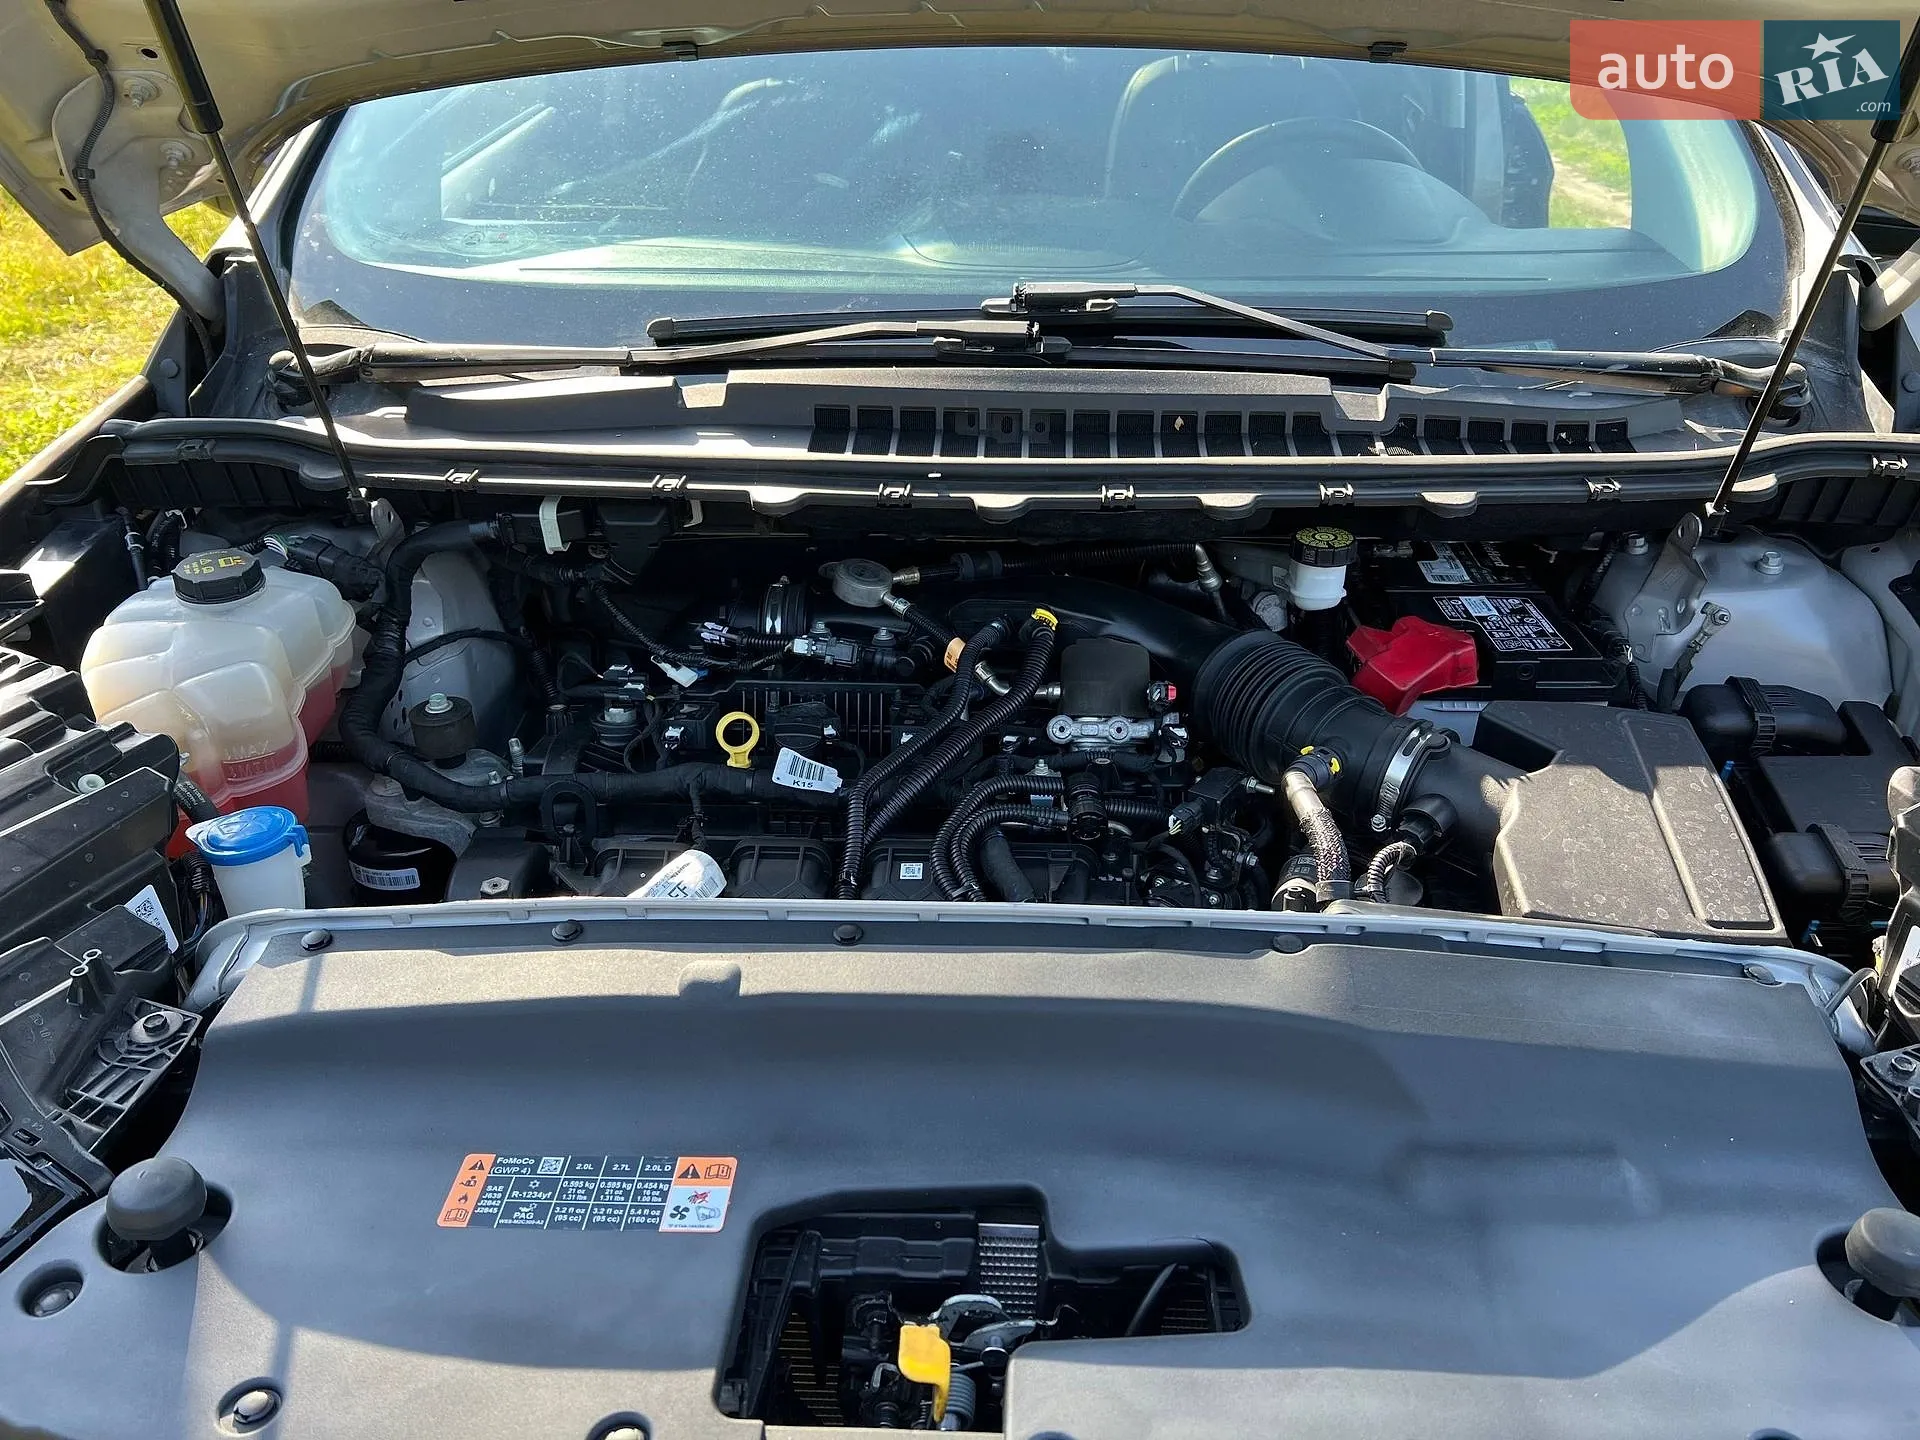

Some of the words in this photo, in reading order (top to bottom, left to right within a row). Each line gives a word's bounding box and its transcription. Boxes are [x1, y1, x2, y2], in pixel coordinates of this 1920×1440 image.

[792, 779, 814, 788] K15
[496, 1157, 535, 1165] FoMoCo
[490, 1167, 519, 1175] (GWP
[519, 1167, 531, 1175] 4)
[584, 1181, 595, 1189] kg
[622, 1182, 633, 1190] kg
[659, 1182, 670, 1191] kg
[511, 1190, 552, 1200] R-1234yf
[569, 1215, 582, 1223] cc)
[607, 1216, 620, 1224] cc)
[628, 1216, 646, 1224] (160
